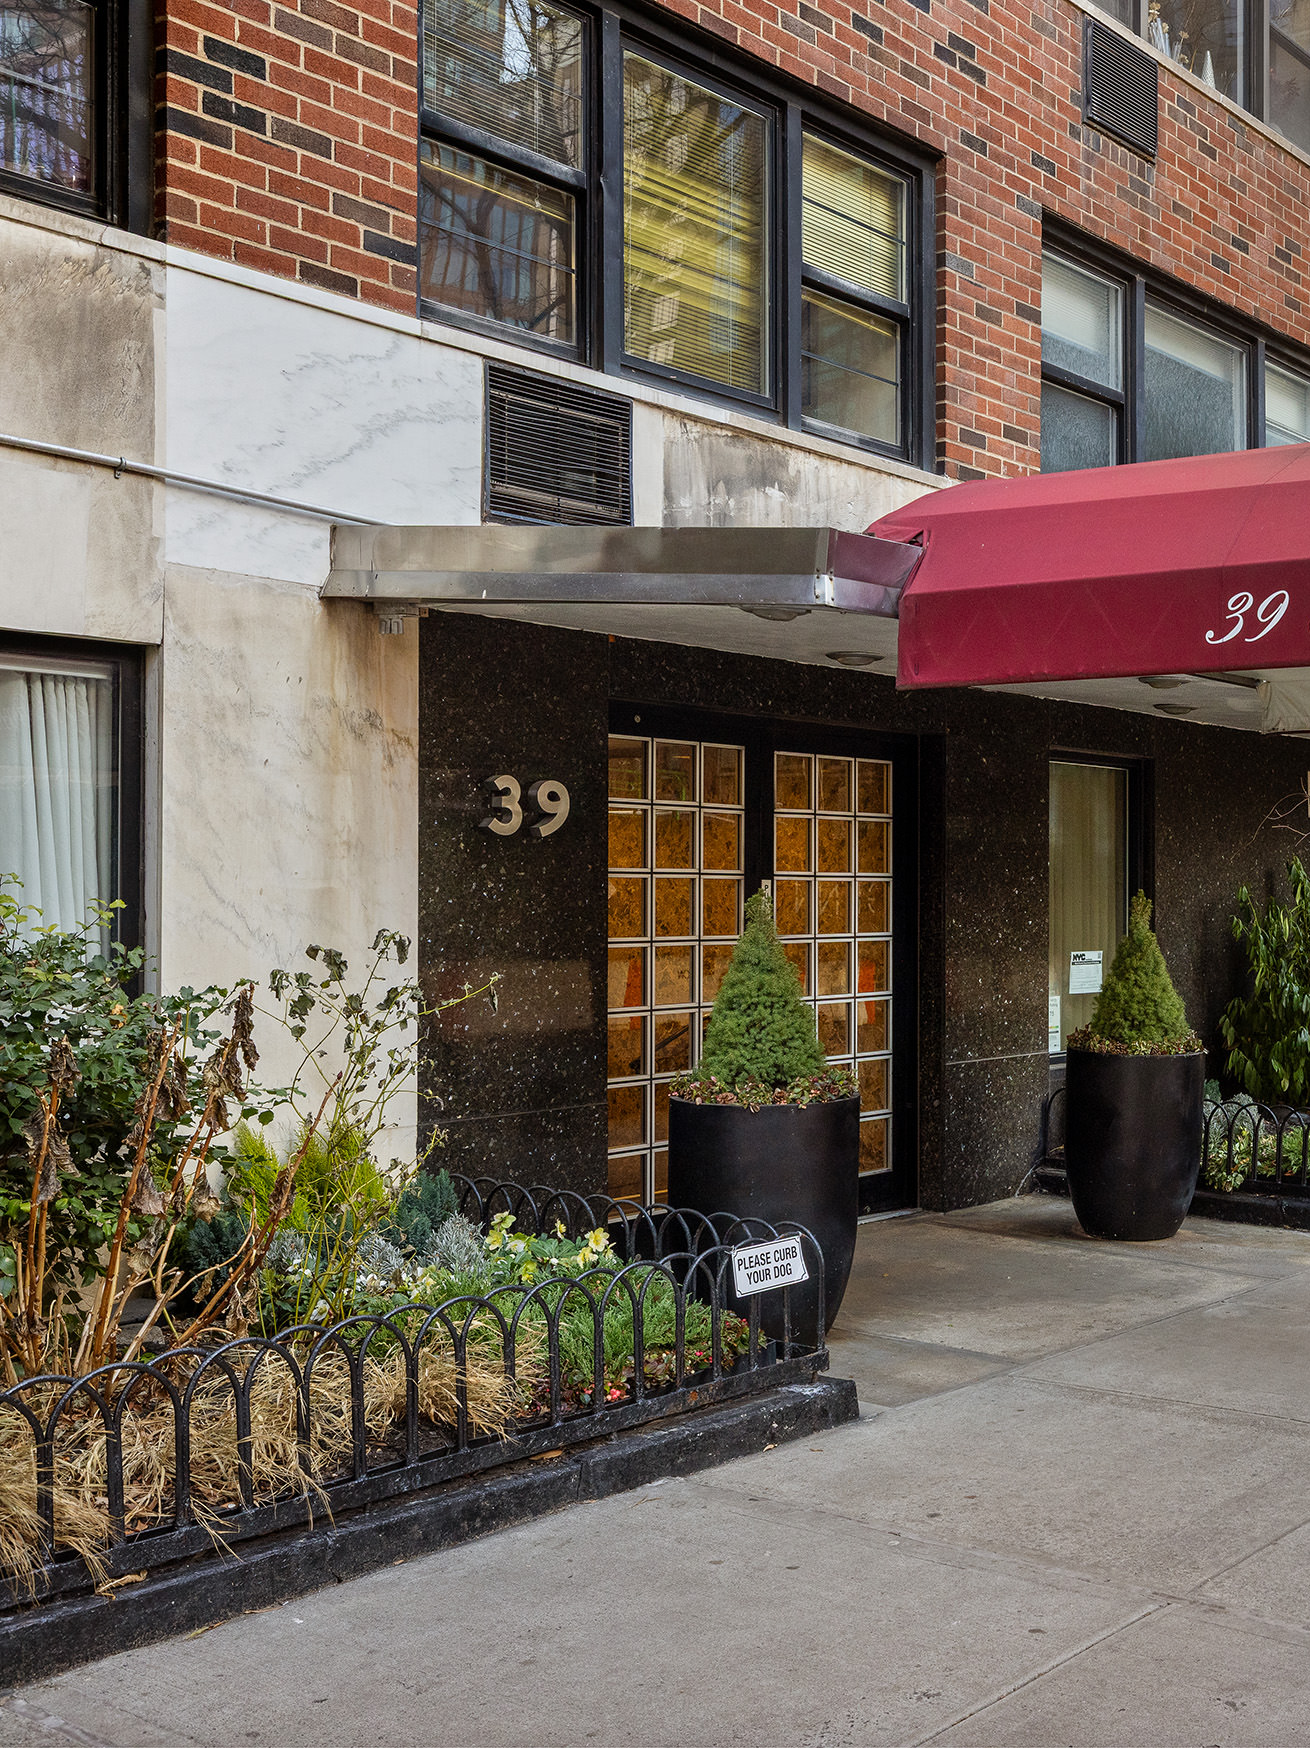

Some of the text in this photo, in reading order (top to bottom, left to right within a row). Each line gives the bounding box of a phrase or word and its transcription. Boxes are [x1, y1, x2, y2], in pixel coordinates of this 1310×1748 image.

[1205, 590, 1289, 644] 39
[484, 774, 570, 837] 39
[1072, 953, 1086, 961] NYC
[737, 1245, 798, 1271] PLEASE CURB
[746, 1262, 793, 1285] YOUR DOG
